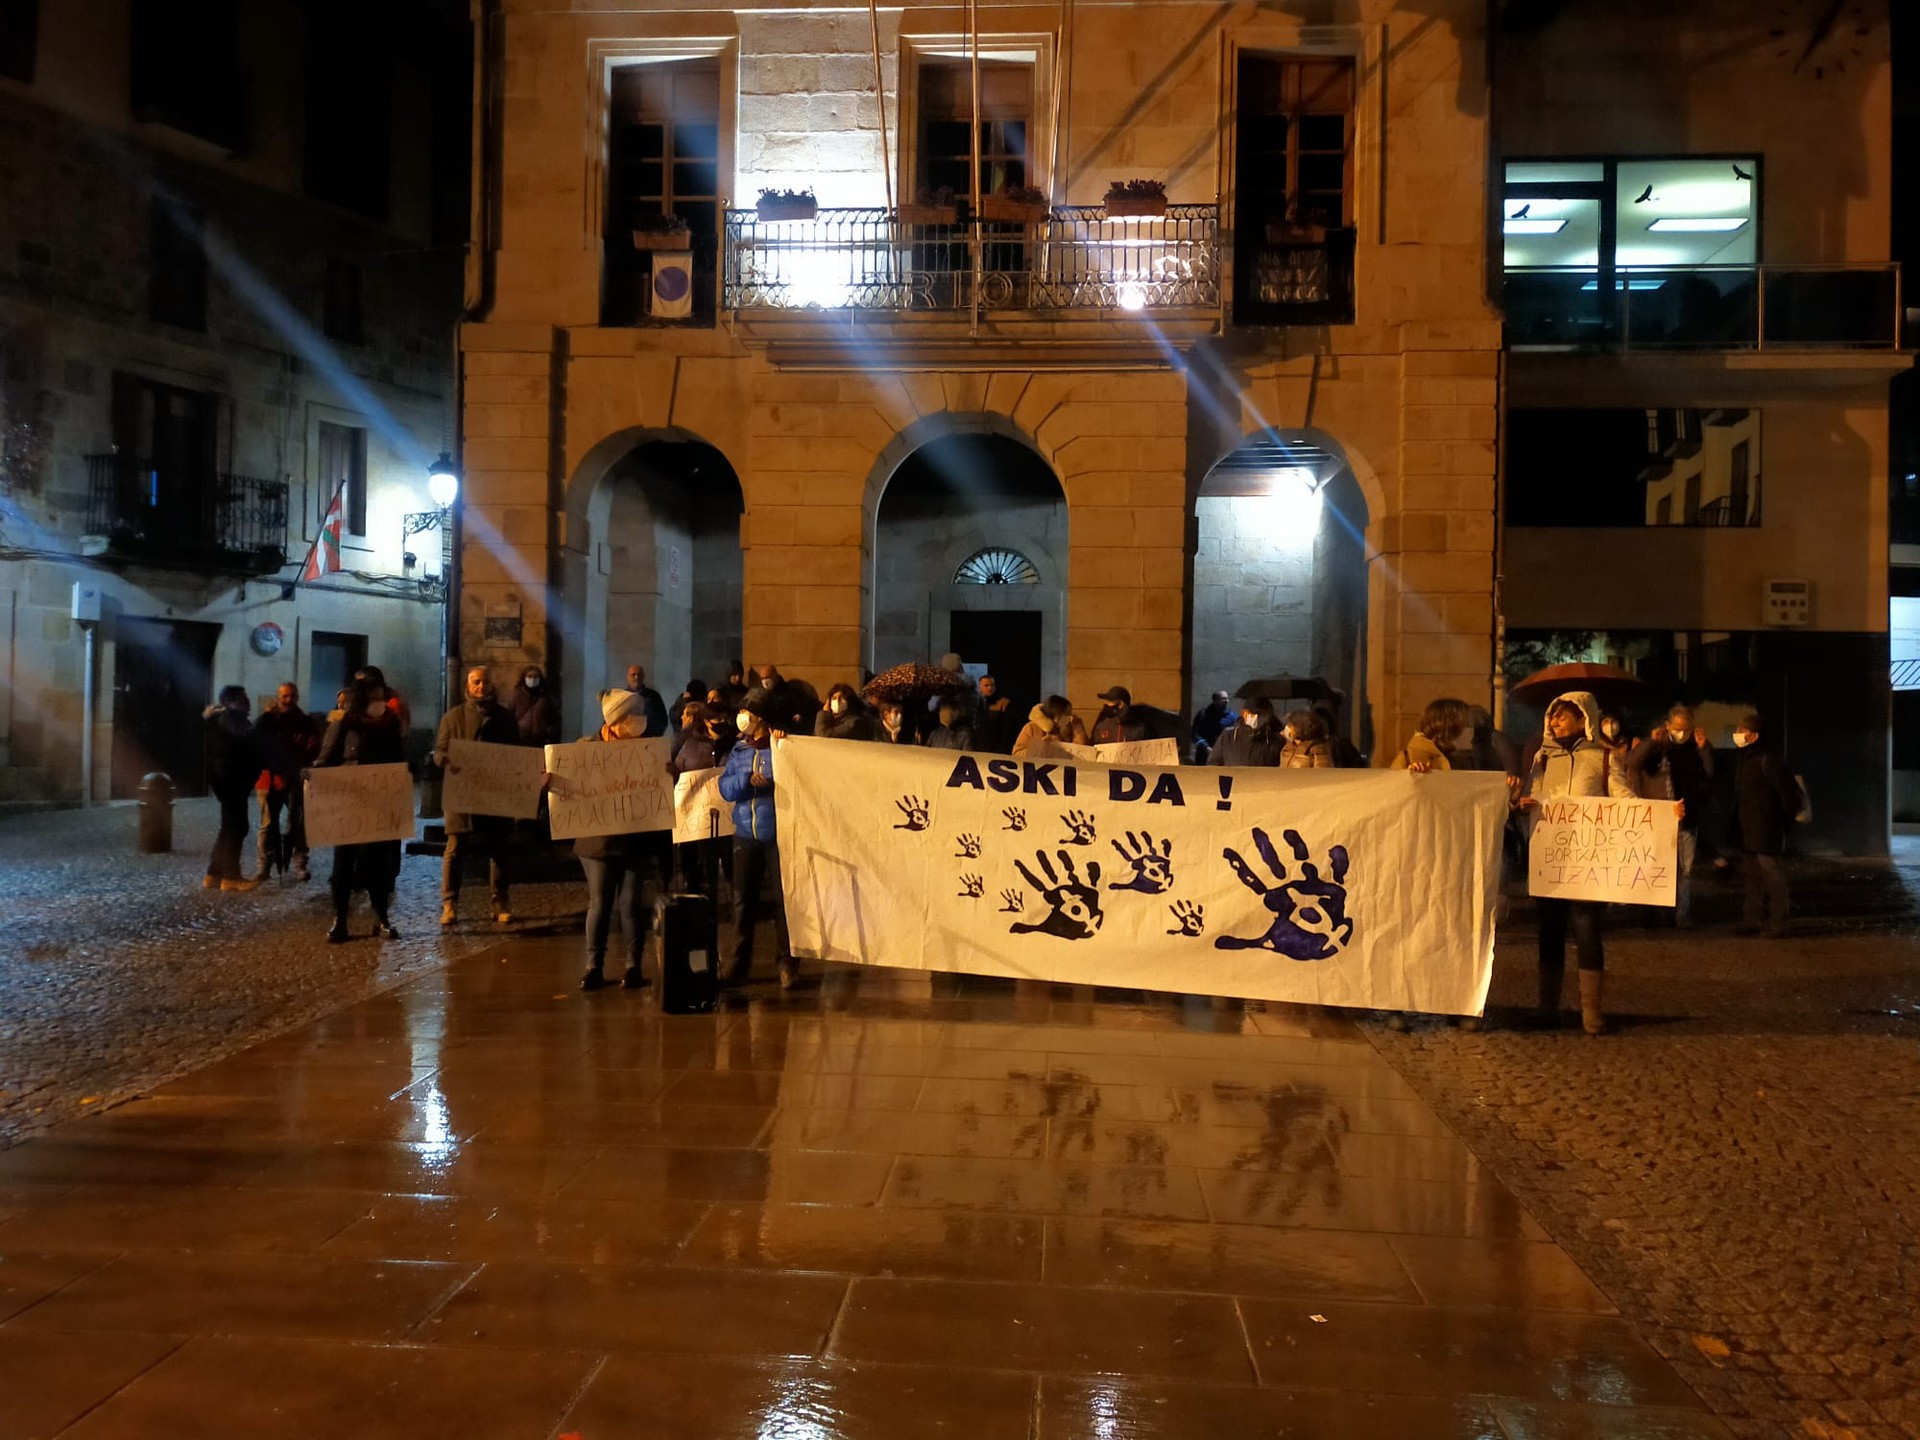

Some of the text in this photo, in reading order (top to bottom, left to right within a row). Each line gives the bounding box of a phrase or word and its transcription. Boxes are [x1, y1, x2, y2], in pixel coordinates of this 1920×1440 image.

[581, 778, 599, 798] la
[605, 773, 661, 795] violencia
[946, 755, 1234, 811] ASKI DA !
[1544, 802, 1654, 830] NAZKATUTA
[1554, 828, 1619, 848] GAUDE
[1544, 845, 1658, 864] BORTXATUAK
[1548, 866, 1668, 890] IZATEAZ
